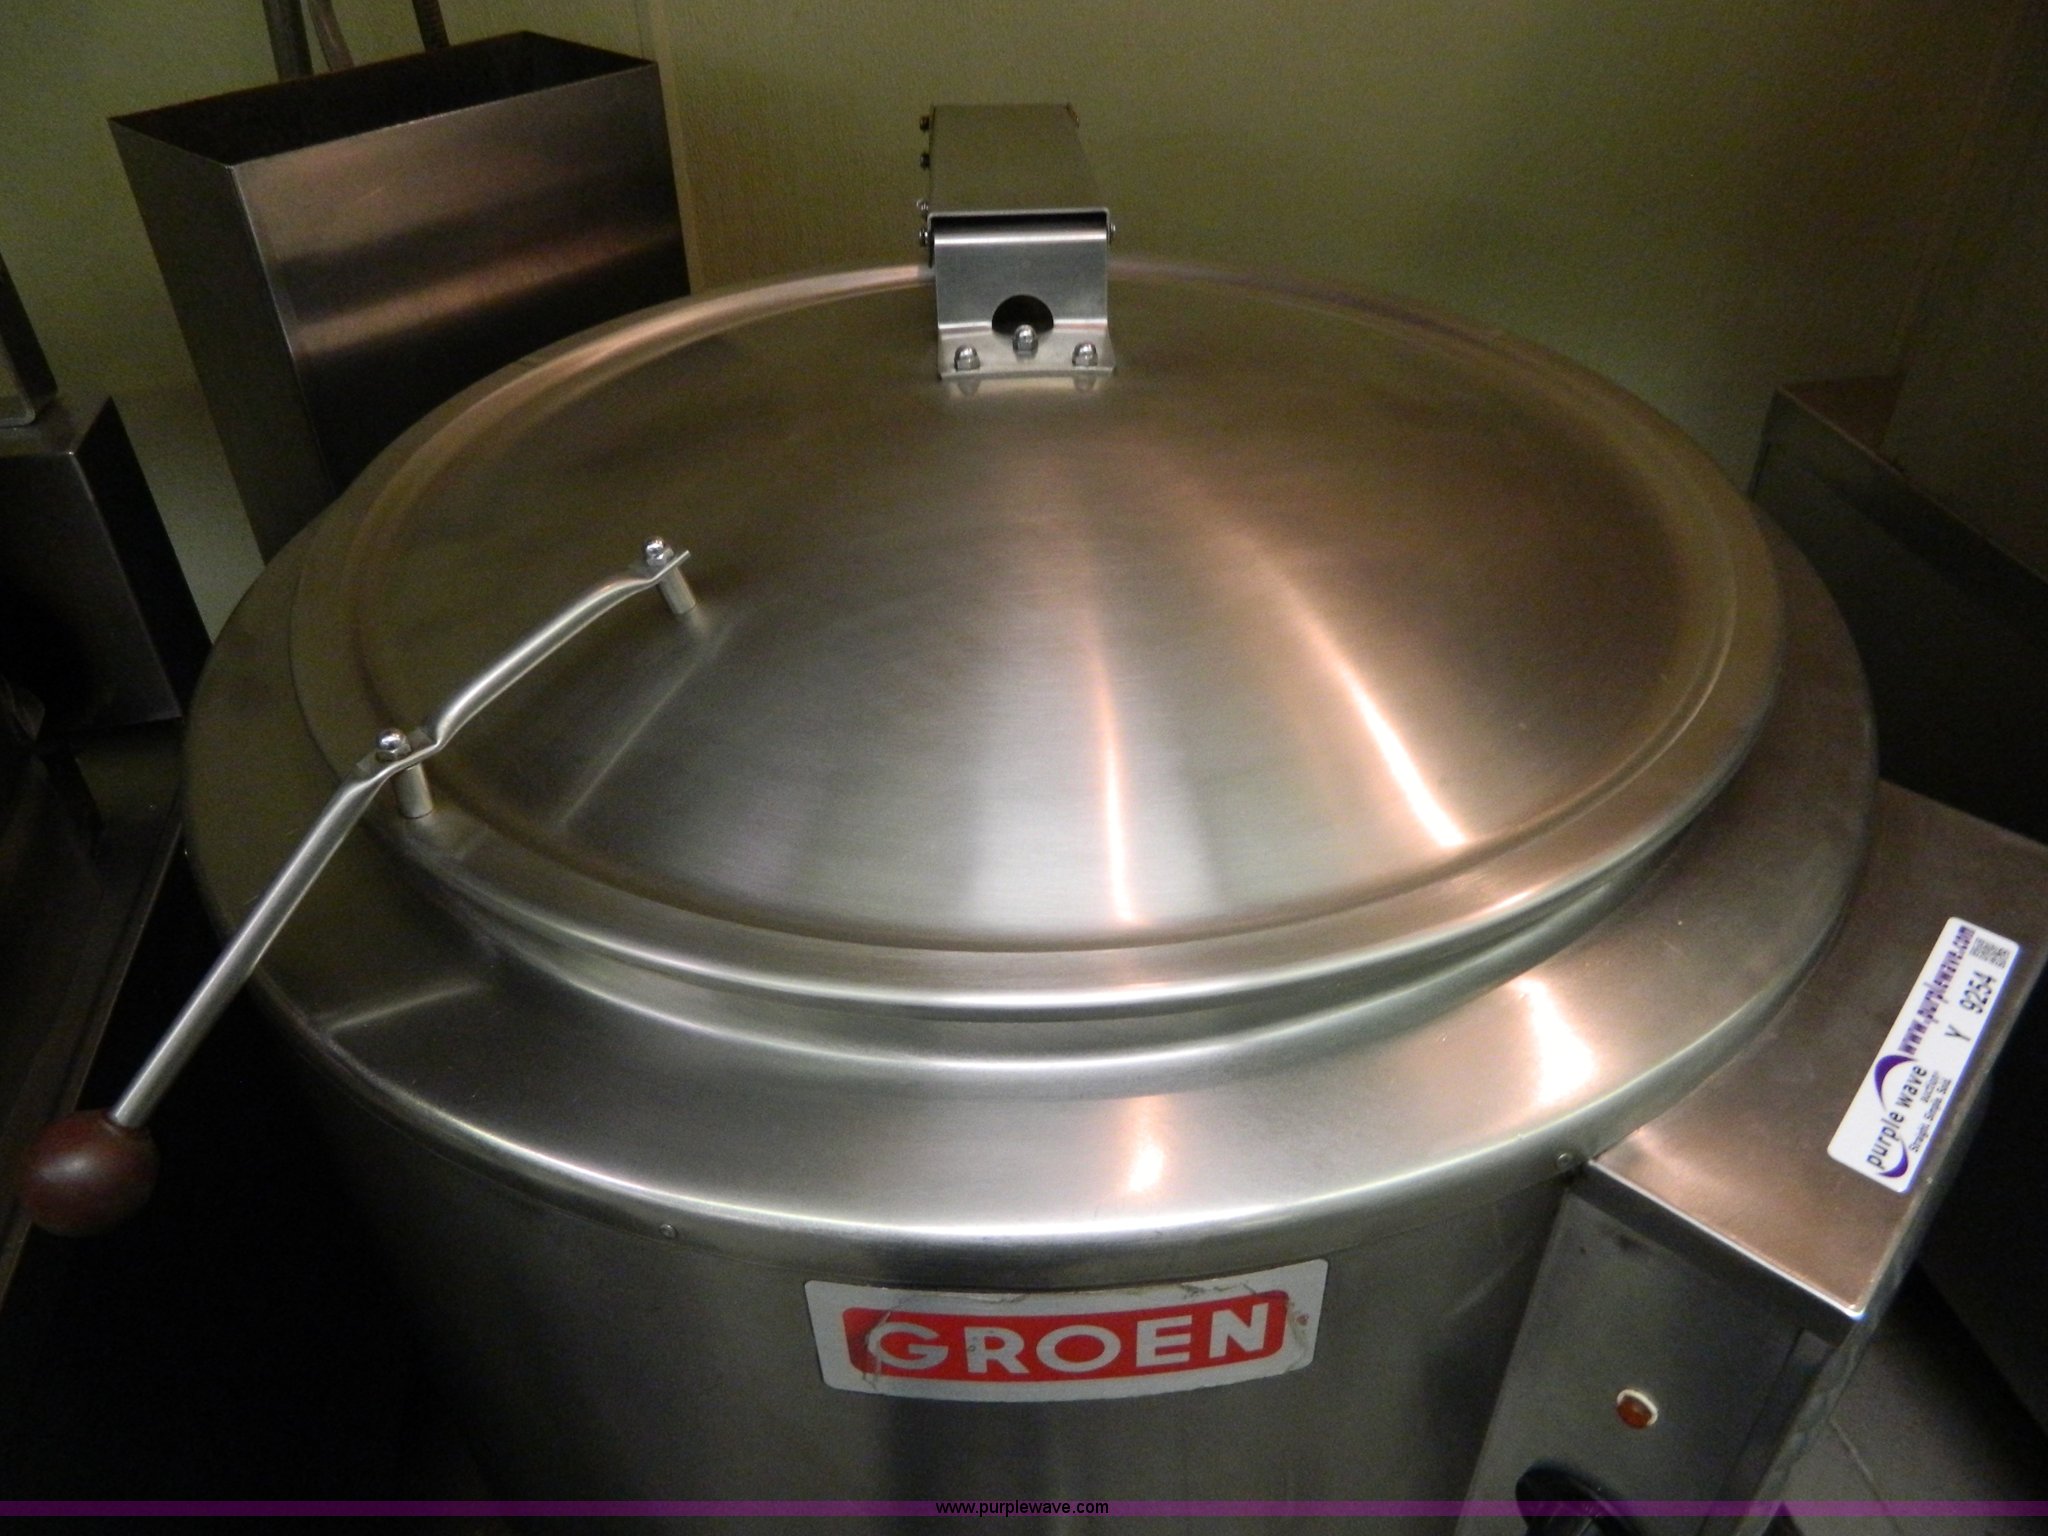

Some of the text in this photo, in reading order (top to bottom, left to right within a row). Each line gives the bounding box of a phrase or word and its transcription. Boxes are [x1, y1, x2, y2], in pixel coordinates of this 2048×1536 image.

[1899, 926, 1975, 1055] www.purplewave.com
[1944, 971, 1997, 1041] Y 9254
[1866, 1065, 1927, 1170] purple wave
[867, 1302, 1270, 1374] GROEN
